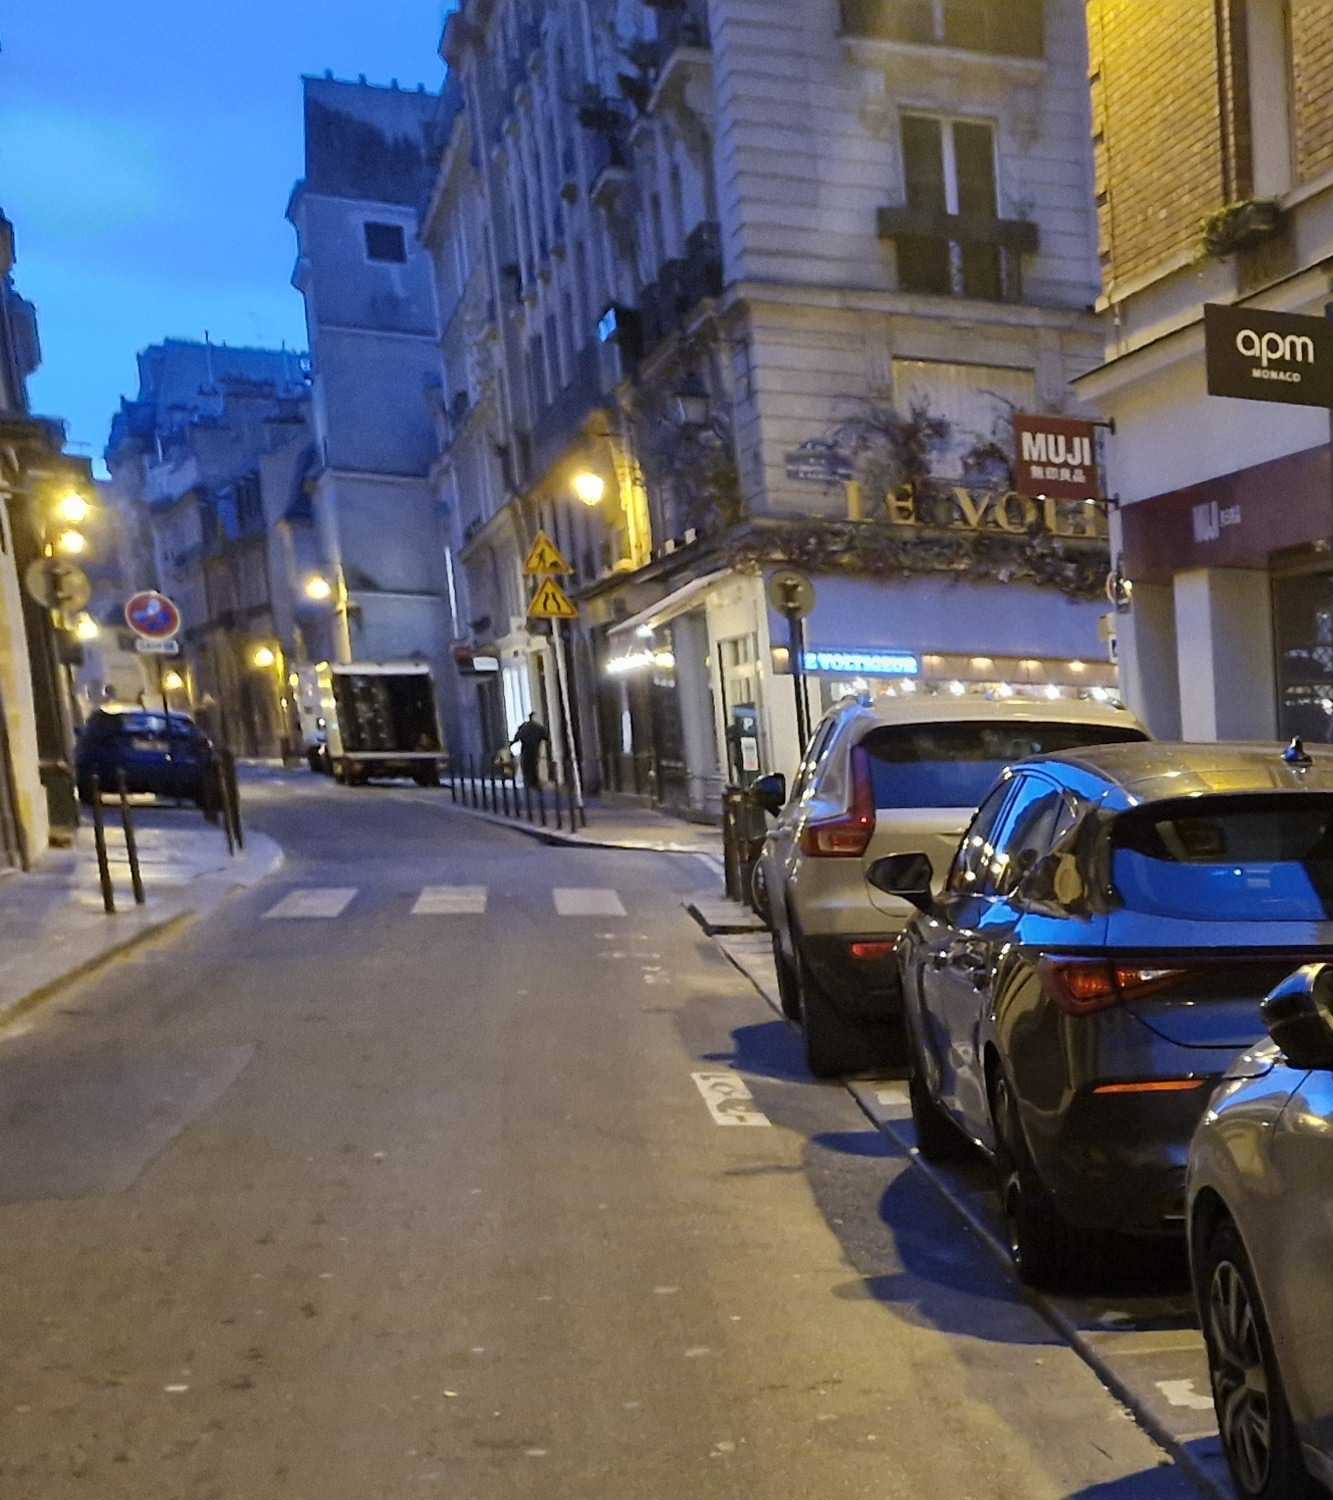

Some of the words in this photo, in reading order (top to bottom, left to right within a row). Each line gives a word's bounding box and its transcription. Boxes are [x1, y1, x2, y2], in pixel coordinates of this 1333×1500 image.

[1236, 329, 1314, 367] apm
[1251, 368, 1301, 382] MONACO
[1021, 431, 1091, 466] MUJI
